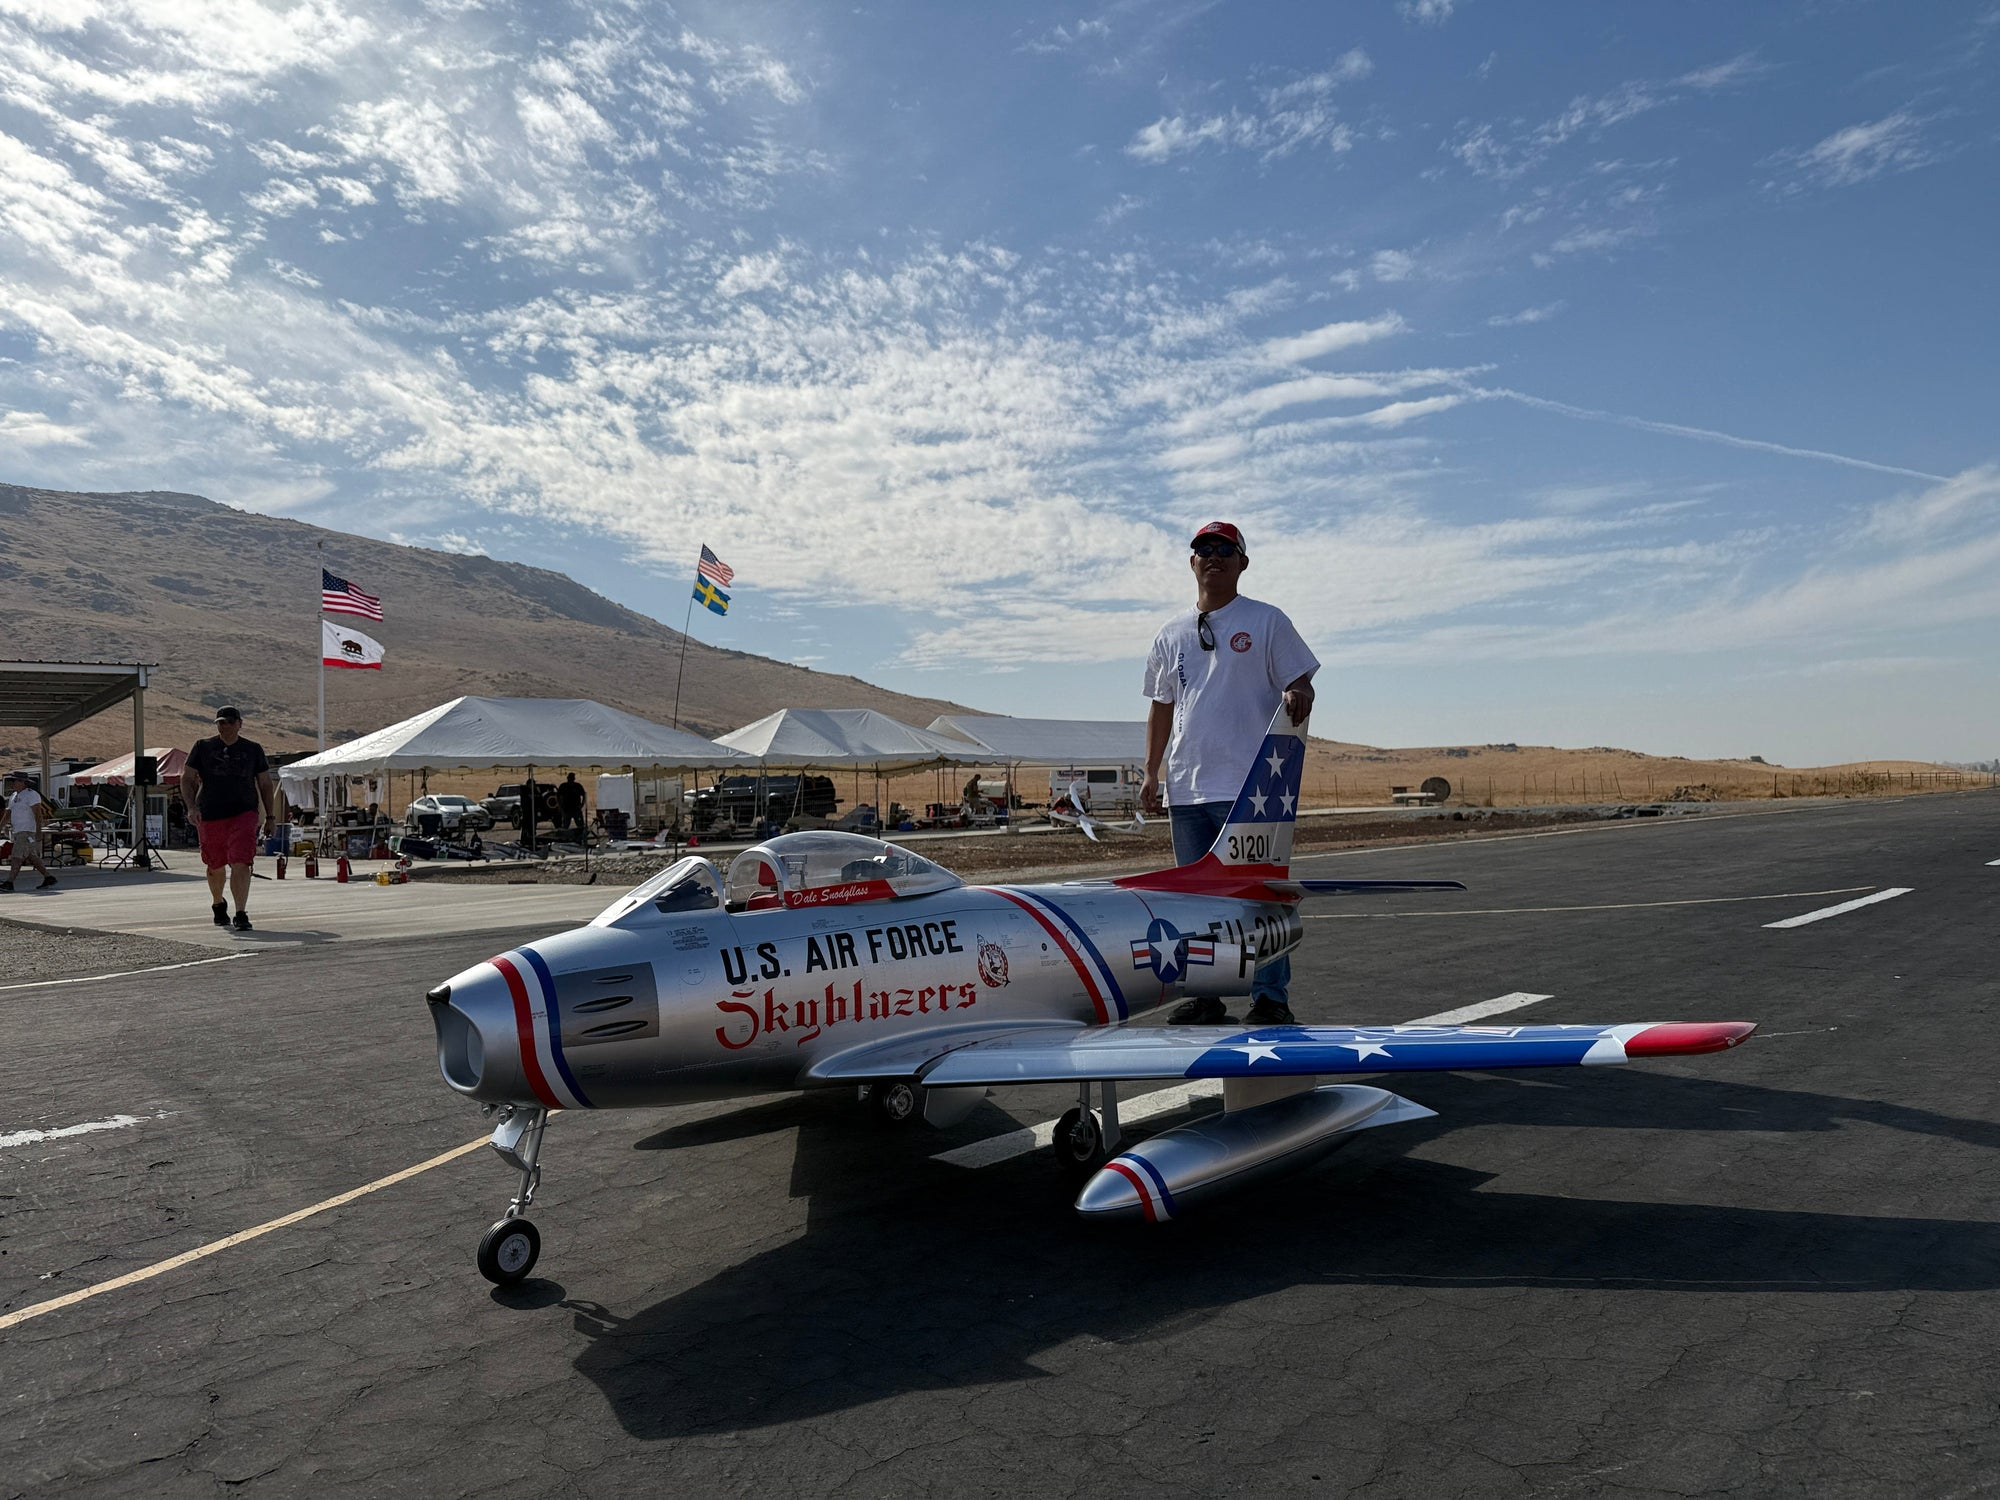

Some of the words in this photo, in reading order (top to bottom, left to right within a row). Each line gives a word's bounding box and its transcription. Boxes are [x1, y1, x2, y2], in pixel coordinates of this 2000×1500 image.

[1227, 834, 1270, 860] 31201
[791, 890, 818, 905] Dale
[720, 942, 791, 985] U.S.
[806, 932, 858, 974] AIR
[865, 920, 964, 963] FORCE
[715, 978, 978, 1050] Skyblazers
